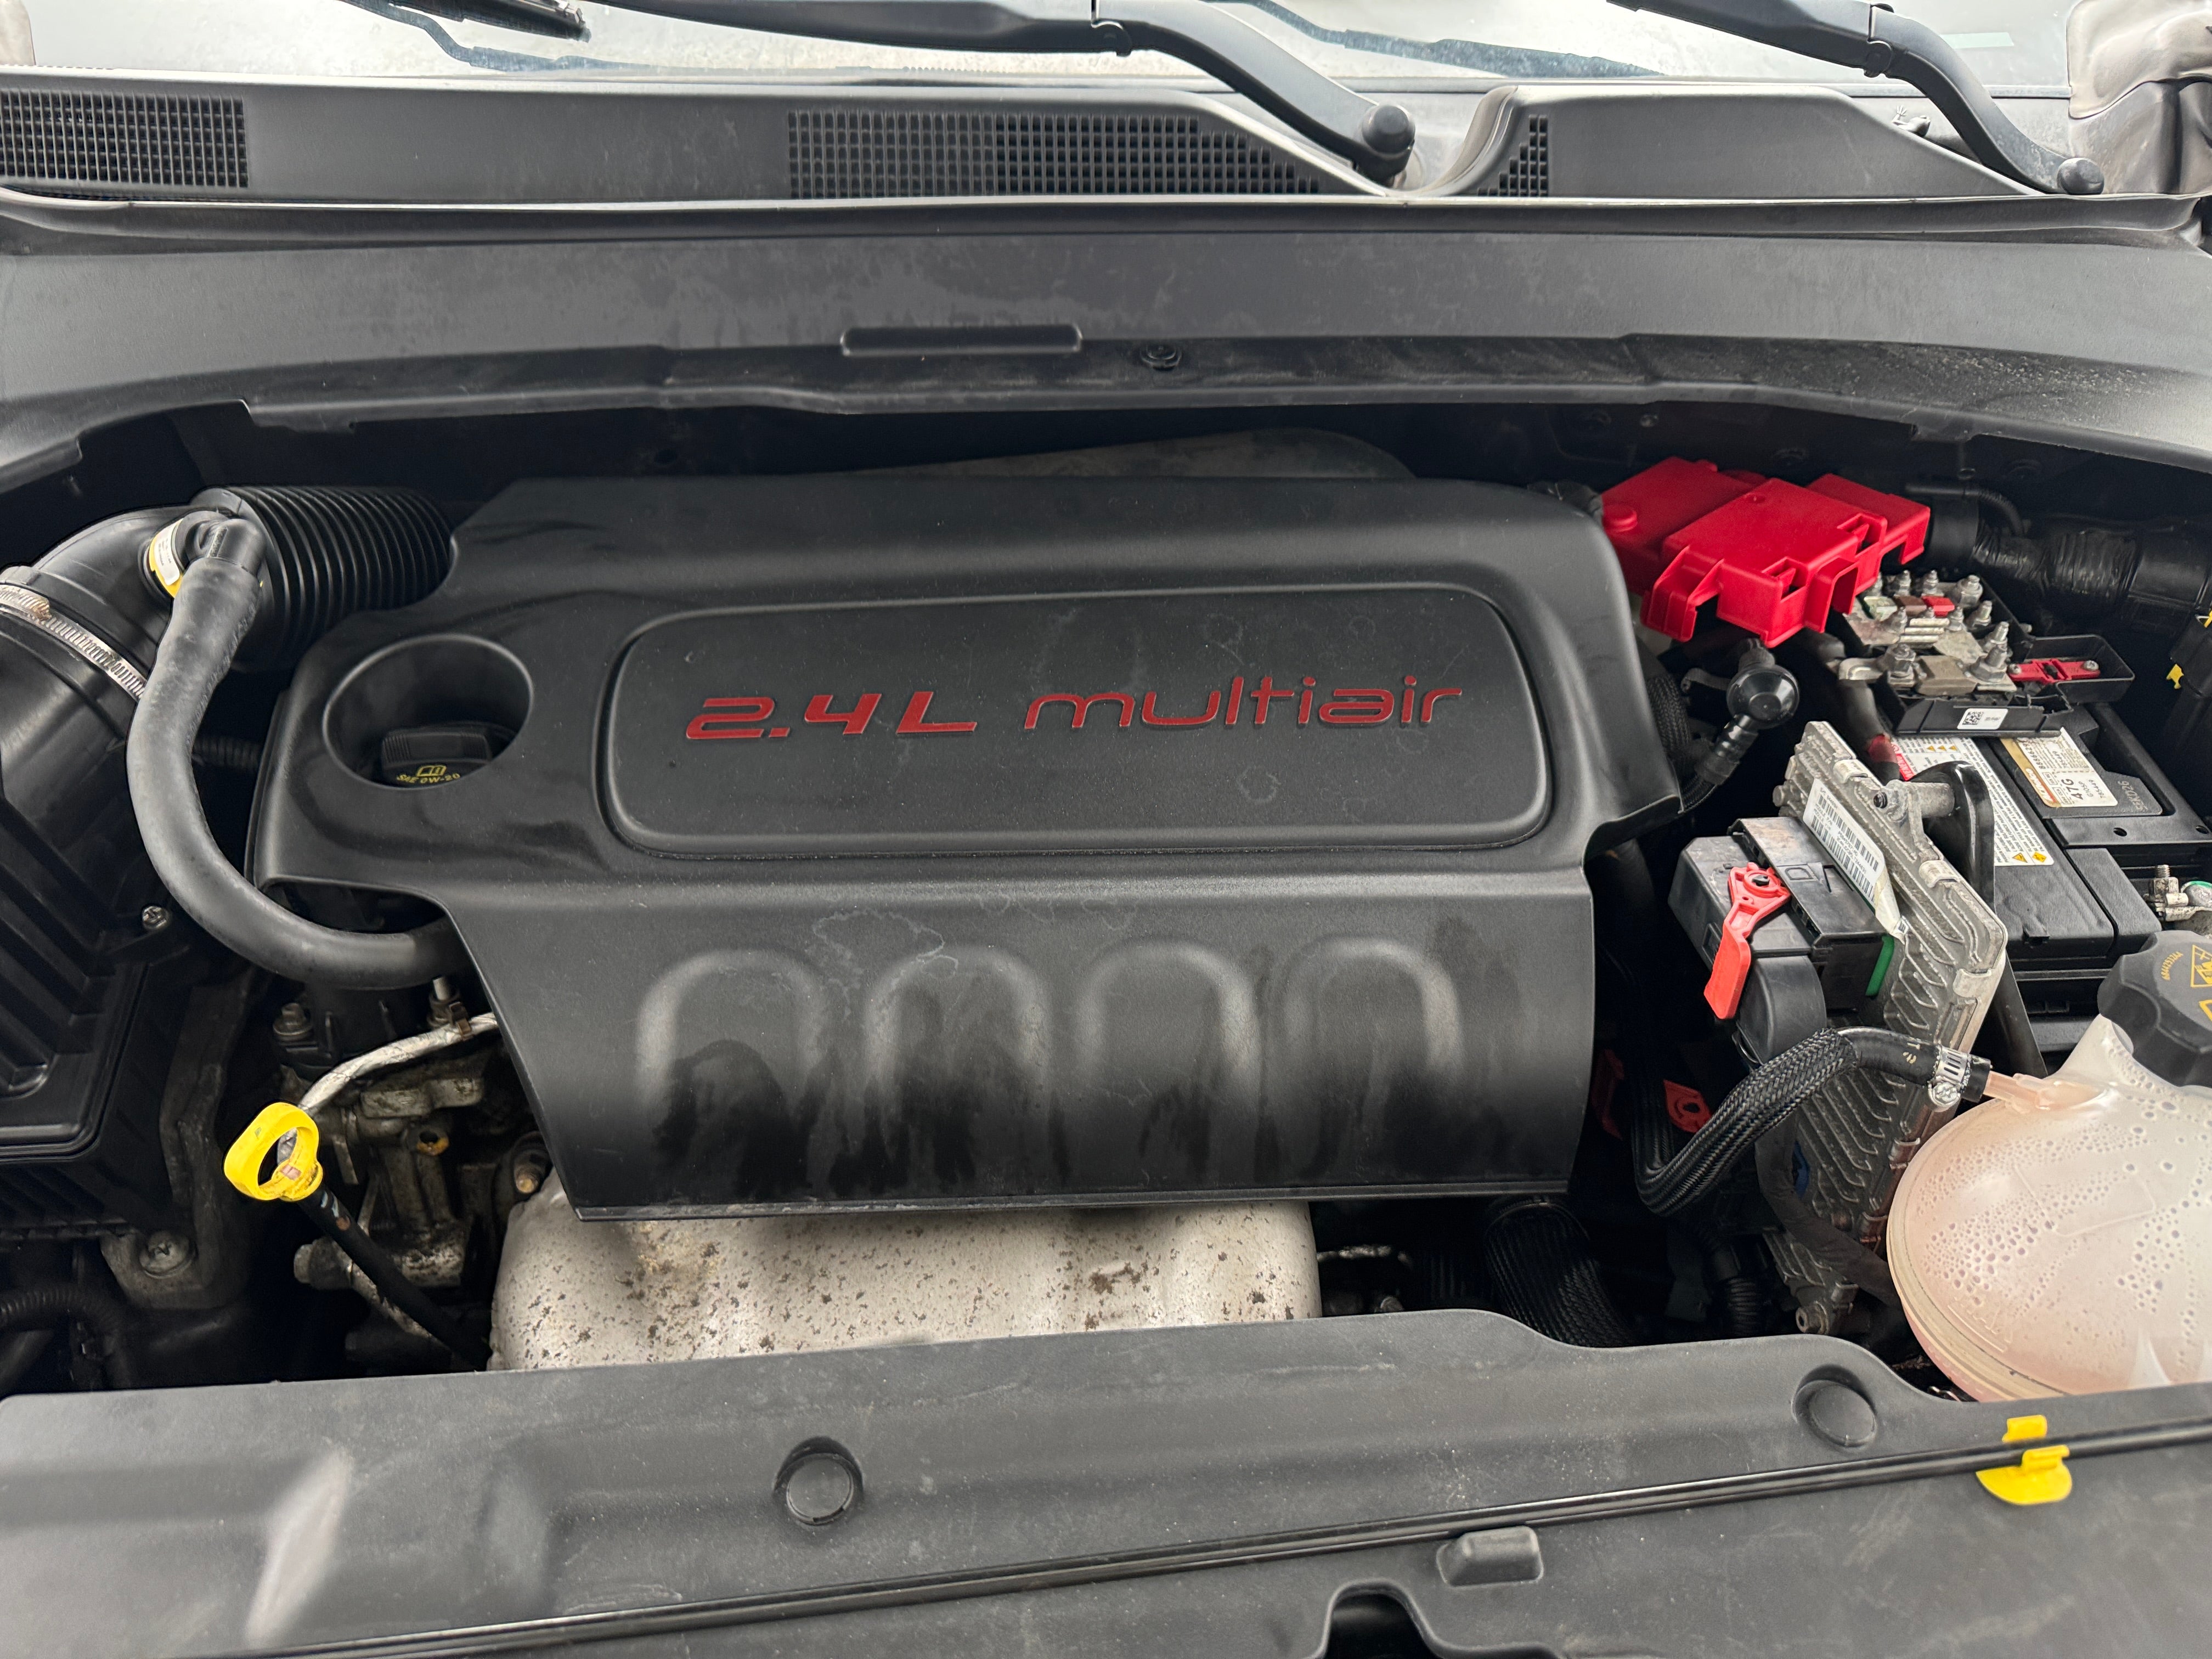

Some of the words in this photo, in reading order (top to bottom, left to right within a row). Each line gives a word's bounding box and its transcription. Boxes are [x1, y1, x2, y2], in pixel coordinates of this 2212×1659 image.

[1024, 675, 1462, 730] multiair
[397, 774, 419, 783] SAE
[420, 772, 460, 783] 0W-20
[2061, 778, 2084, 800] 47G
